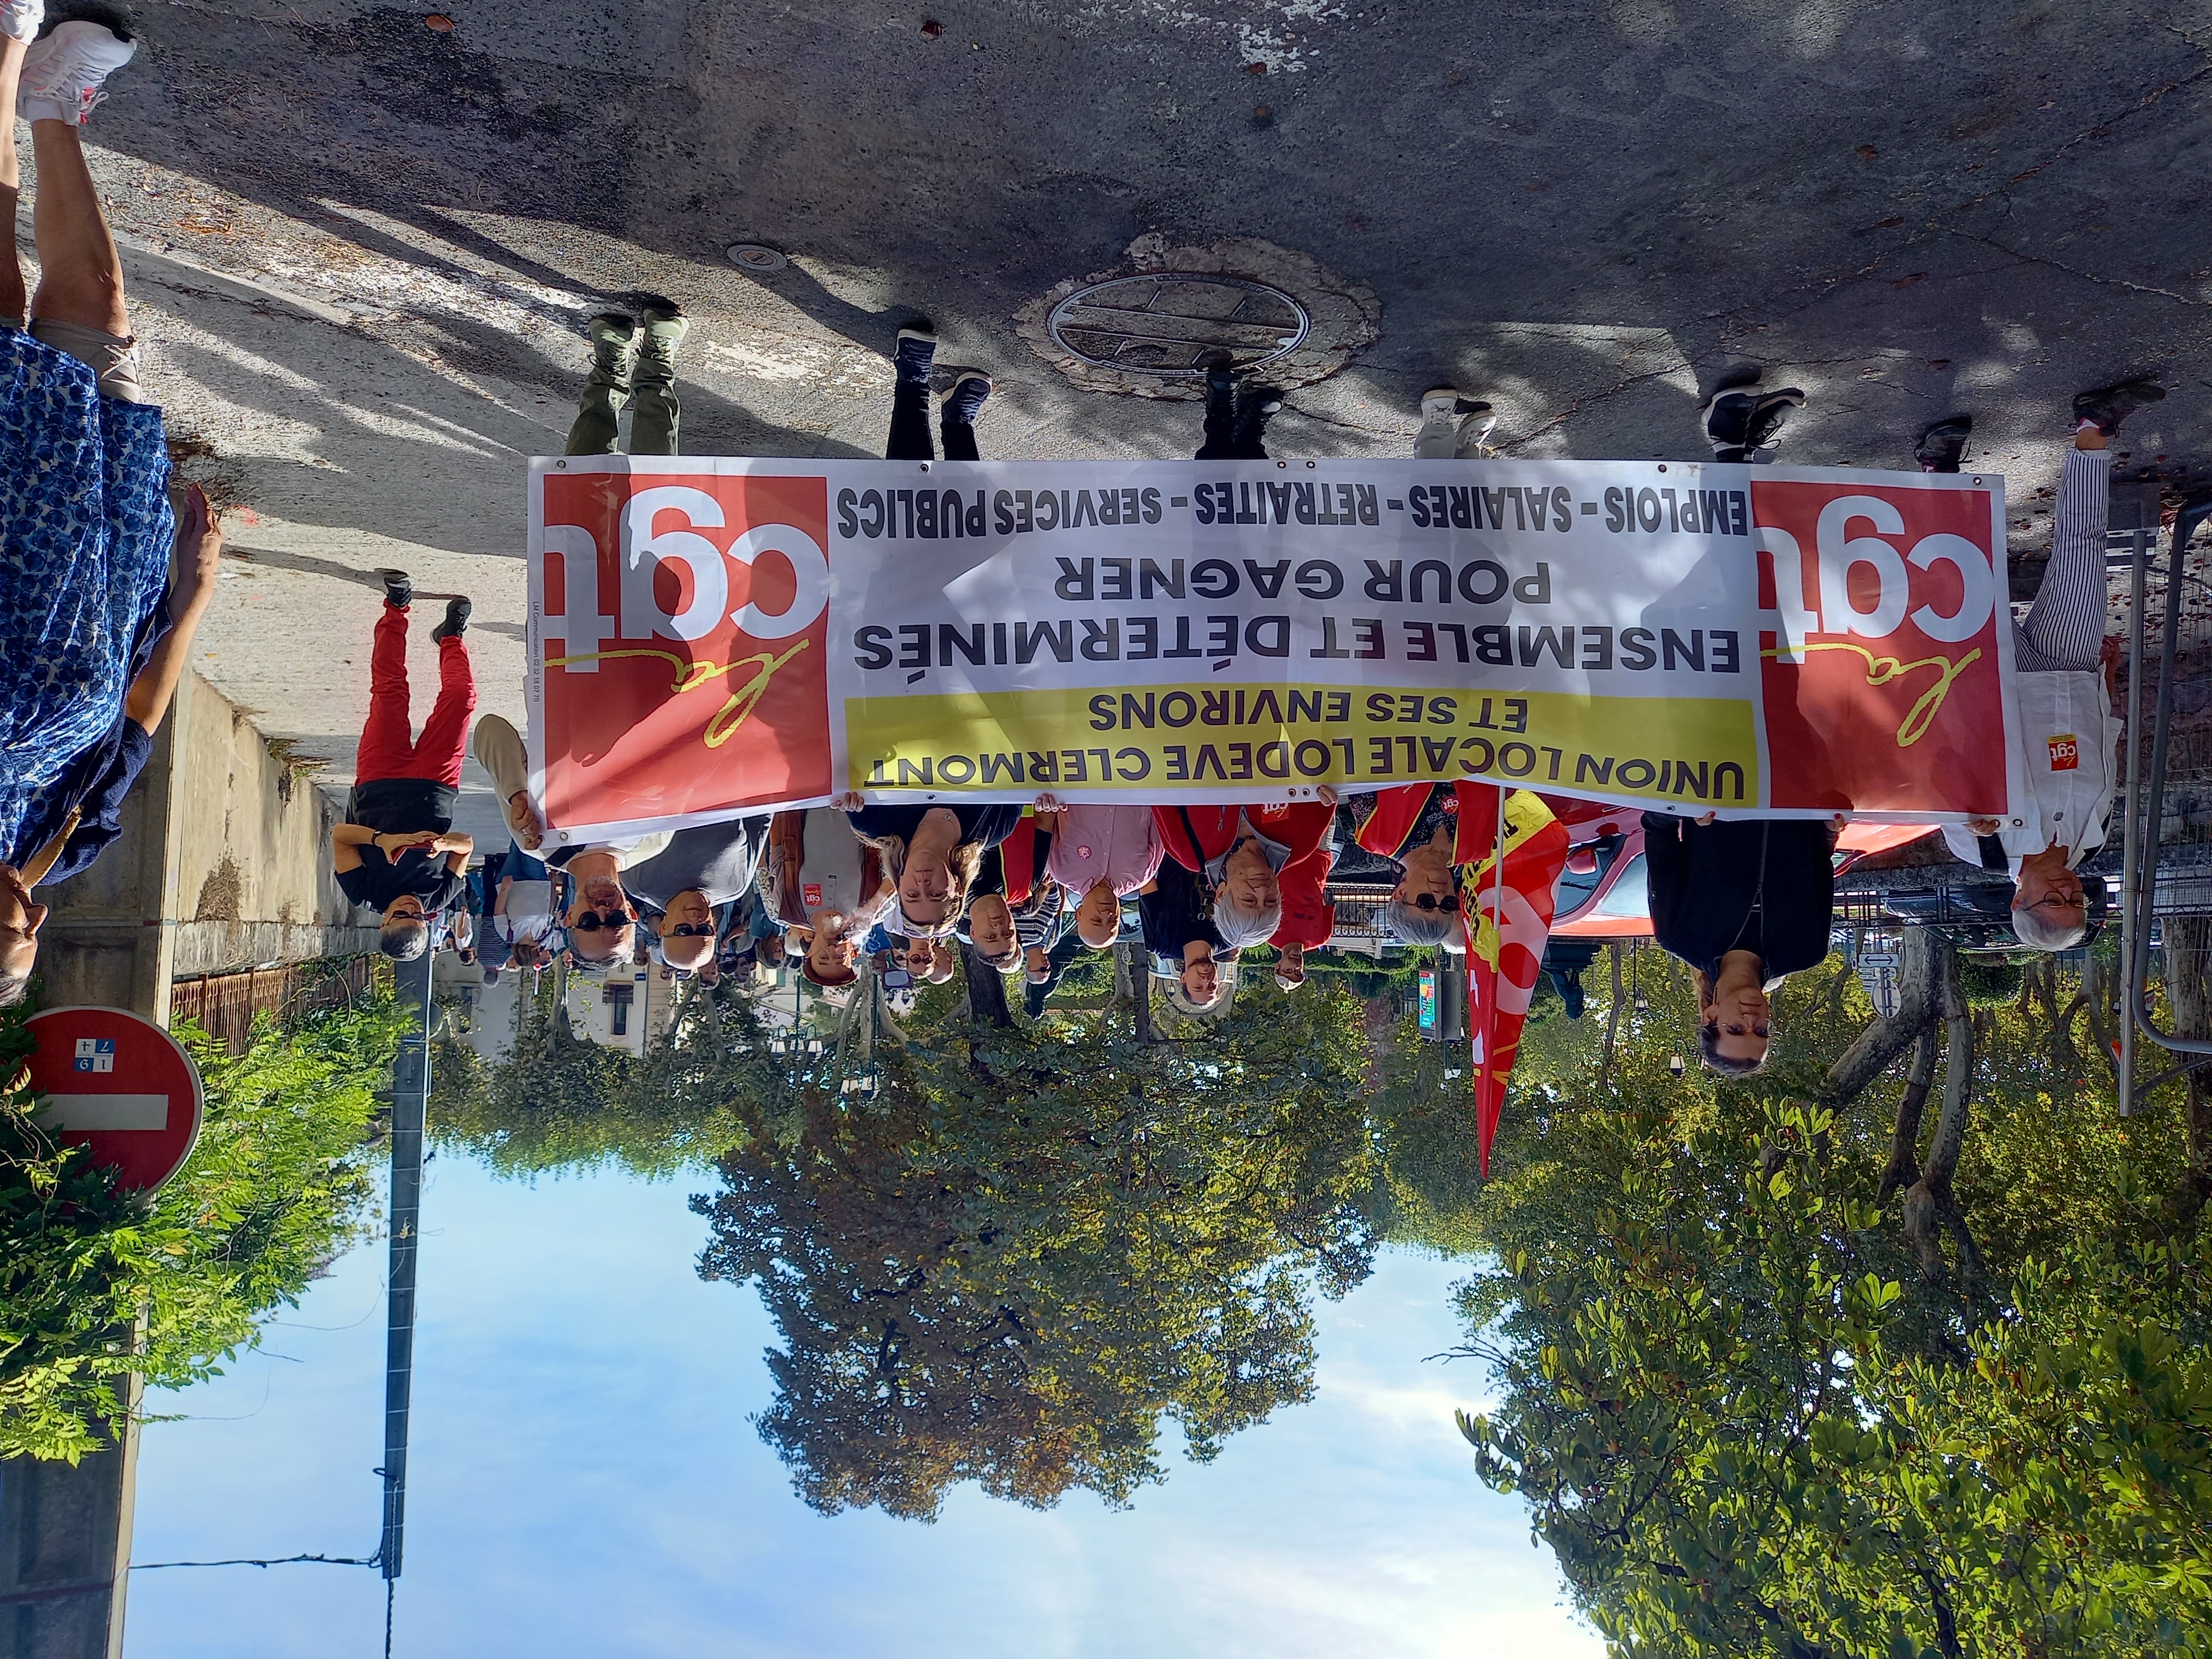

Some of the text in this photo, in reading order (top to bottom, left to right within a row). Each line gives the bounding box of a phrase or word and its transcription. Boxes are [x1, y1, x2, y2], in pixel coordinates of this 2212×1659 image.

[837, 487, 987, 539] PUBLICS
[994, 487, 1162, 533] SERVICES
[1194, 481, 1379, 526] RETRAITES
[1408, 486, 1572, 533] SALAIRES
[1605, 486, 1748, 536] EMPLOIS
[544, 485, 830, 674] cgt
[1053, 556, 1551, 604] POUR GAGNER
[1754, 495, 1994, 665] cgt
[533, 602, 539, 611] LM
[853, 614, 1740, 685] ENSEMBLE ET DÉTERMINÉS
[544, 639, 810, 749] la
[1088, 690, 1528, 734] ET SES ENVIRONS
[1760, 643, 1981, 748] la
[864, 736, 1744, 800] UNION LOCALE LODEVE CLERMONT
[2050, 743, 2076, 761] cgt
[1443, 799, 1459, 809] cgt
